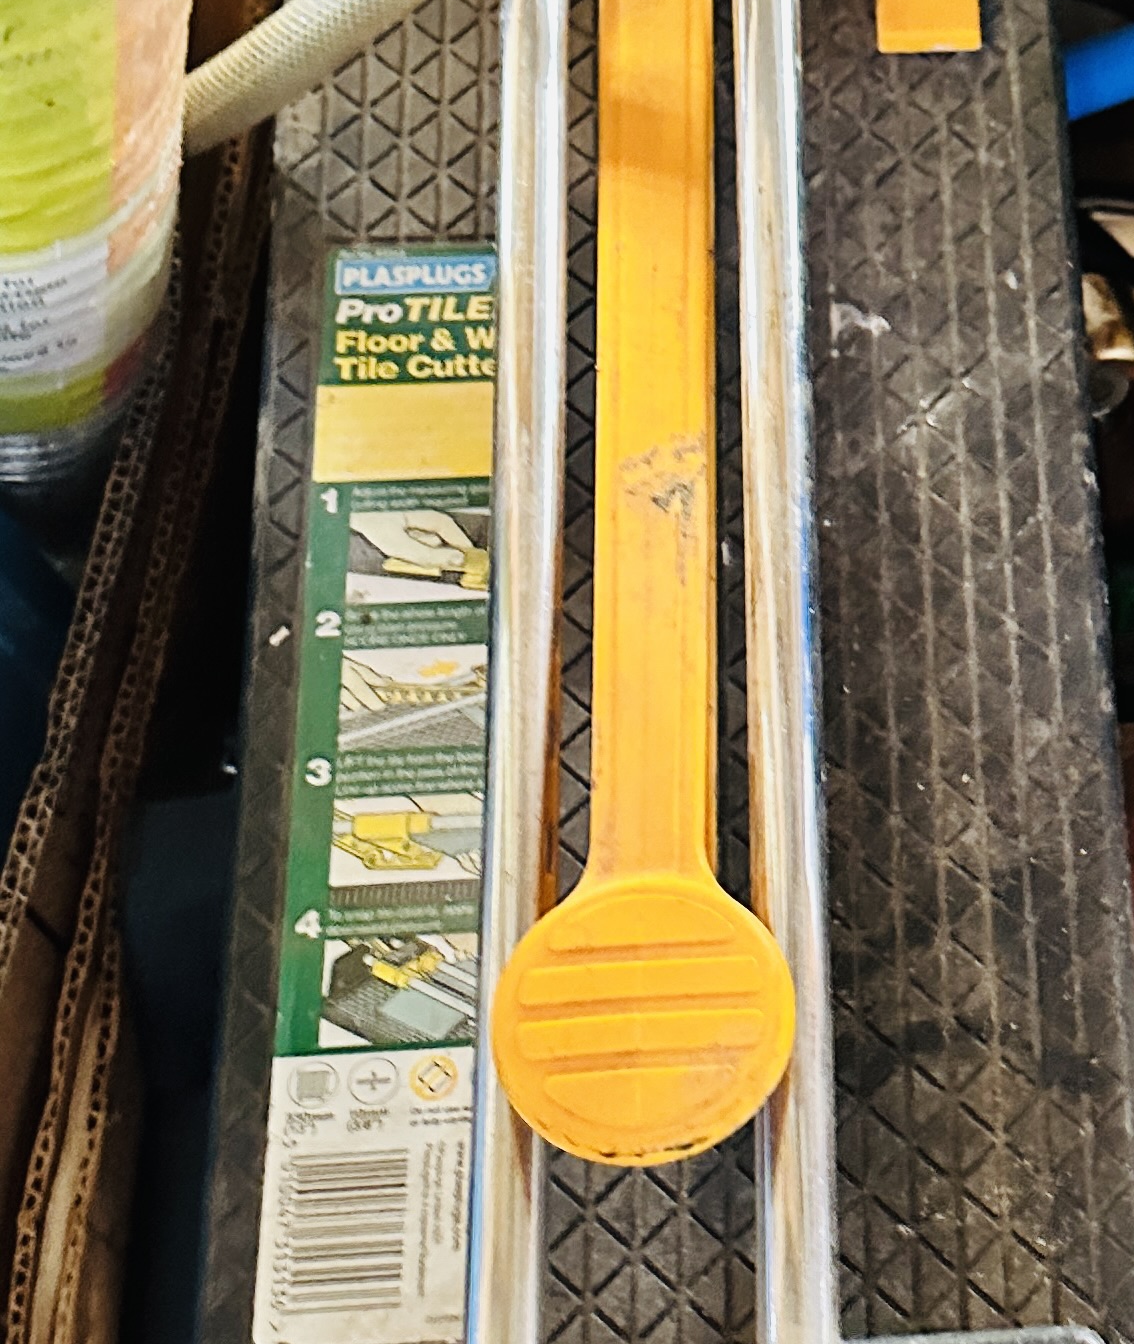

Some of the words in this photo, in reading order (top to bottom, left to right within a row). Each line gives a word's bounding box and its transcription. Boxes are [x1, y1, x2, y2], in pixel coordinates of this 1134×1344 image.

[342, 263, 487, 288] PLASPLUGS
[334, 294, 494, 325] ProTILE
[335, 330, 425, 355] Floor
[430, 327, 456, 352] &
[464, 325, 495, 351] W
[333, 355, 399, 382] Tile
[406, 353, 496, 379] Cutte
[320, 487, 339, 514] 1
[315, 610, 342, 638] 2
[305, 757, 333, 787] 3
[294, 908, 322, 940] 4
